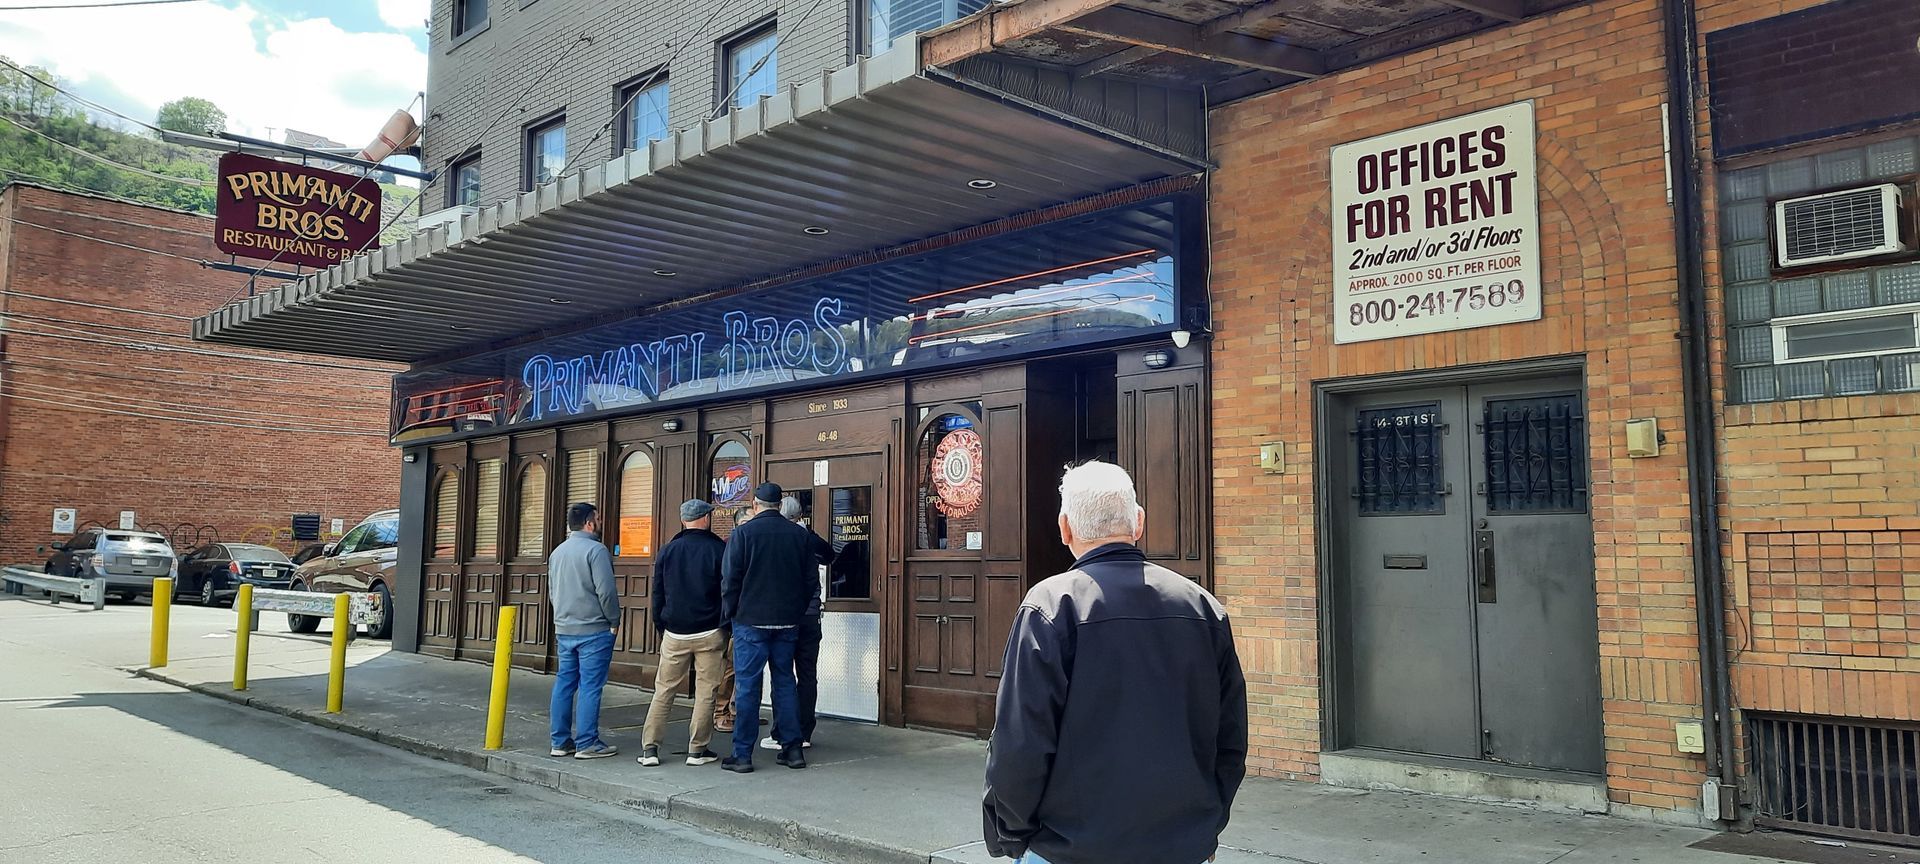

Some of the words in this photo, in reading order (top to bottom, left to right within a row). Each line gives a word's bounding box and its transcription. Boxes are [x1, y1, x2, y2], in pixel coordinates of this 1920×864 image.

[1357, 125, 1506, 195] OFFICES
[226, 171, 375, 223] PRIMANTI
[1347, 194, 1411, 243] FOR
[1424, 171, 1518, 229] RENT
[257, 203, 349, 242] BROS.
[223, 228, 327, 258] RESTAURANT
[326, 248, 339, 260] &
[1348, 244, 1389, 271] 2'nd
[1386, 236, 1448, 265] and/or
[1446, 229, 1475, 255] 3'd
[1473, 226, 1523, 251] Floors
[1349, 276, 1390, 292] APPROX.
[1393, 271, 1423, 286] 2000
[1427, 267, 1445, 281] SQ.
[1447, 264, 1463, 278] FT.
[1464, 260, 1485, 275] PER
[1488, 255, 1522, 271] FLOOR
[1349, 279, 1525, 327] 800-241-7589
[523, 332, 705, 420] PRIMANTI
[808, 403, 827, 413] Since
[833, 398, 848, 410] 1933
[1420, 413, 1436, 424] ST
[817, 430, 838, 442] 46-48
[835, 515, 869, 525] PRIMANTI
[842, 525, 863, 534] BROS.
